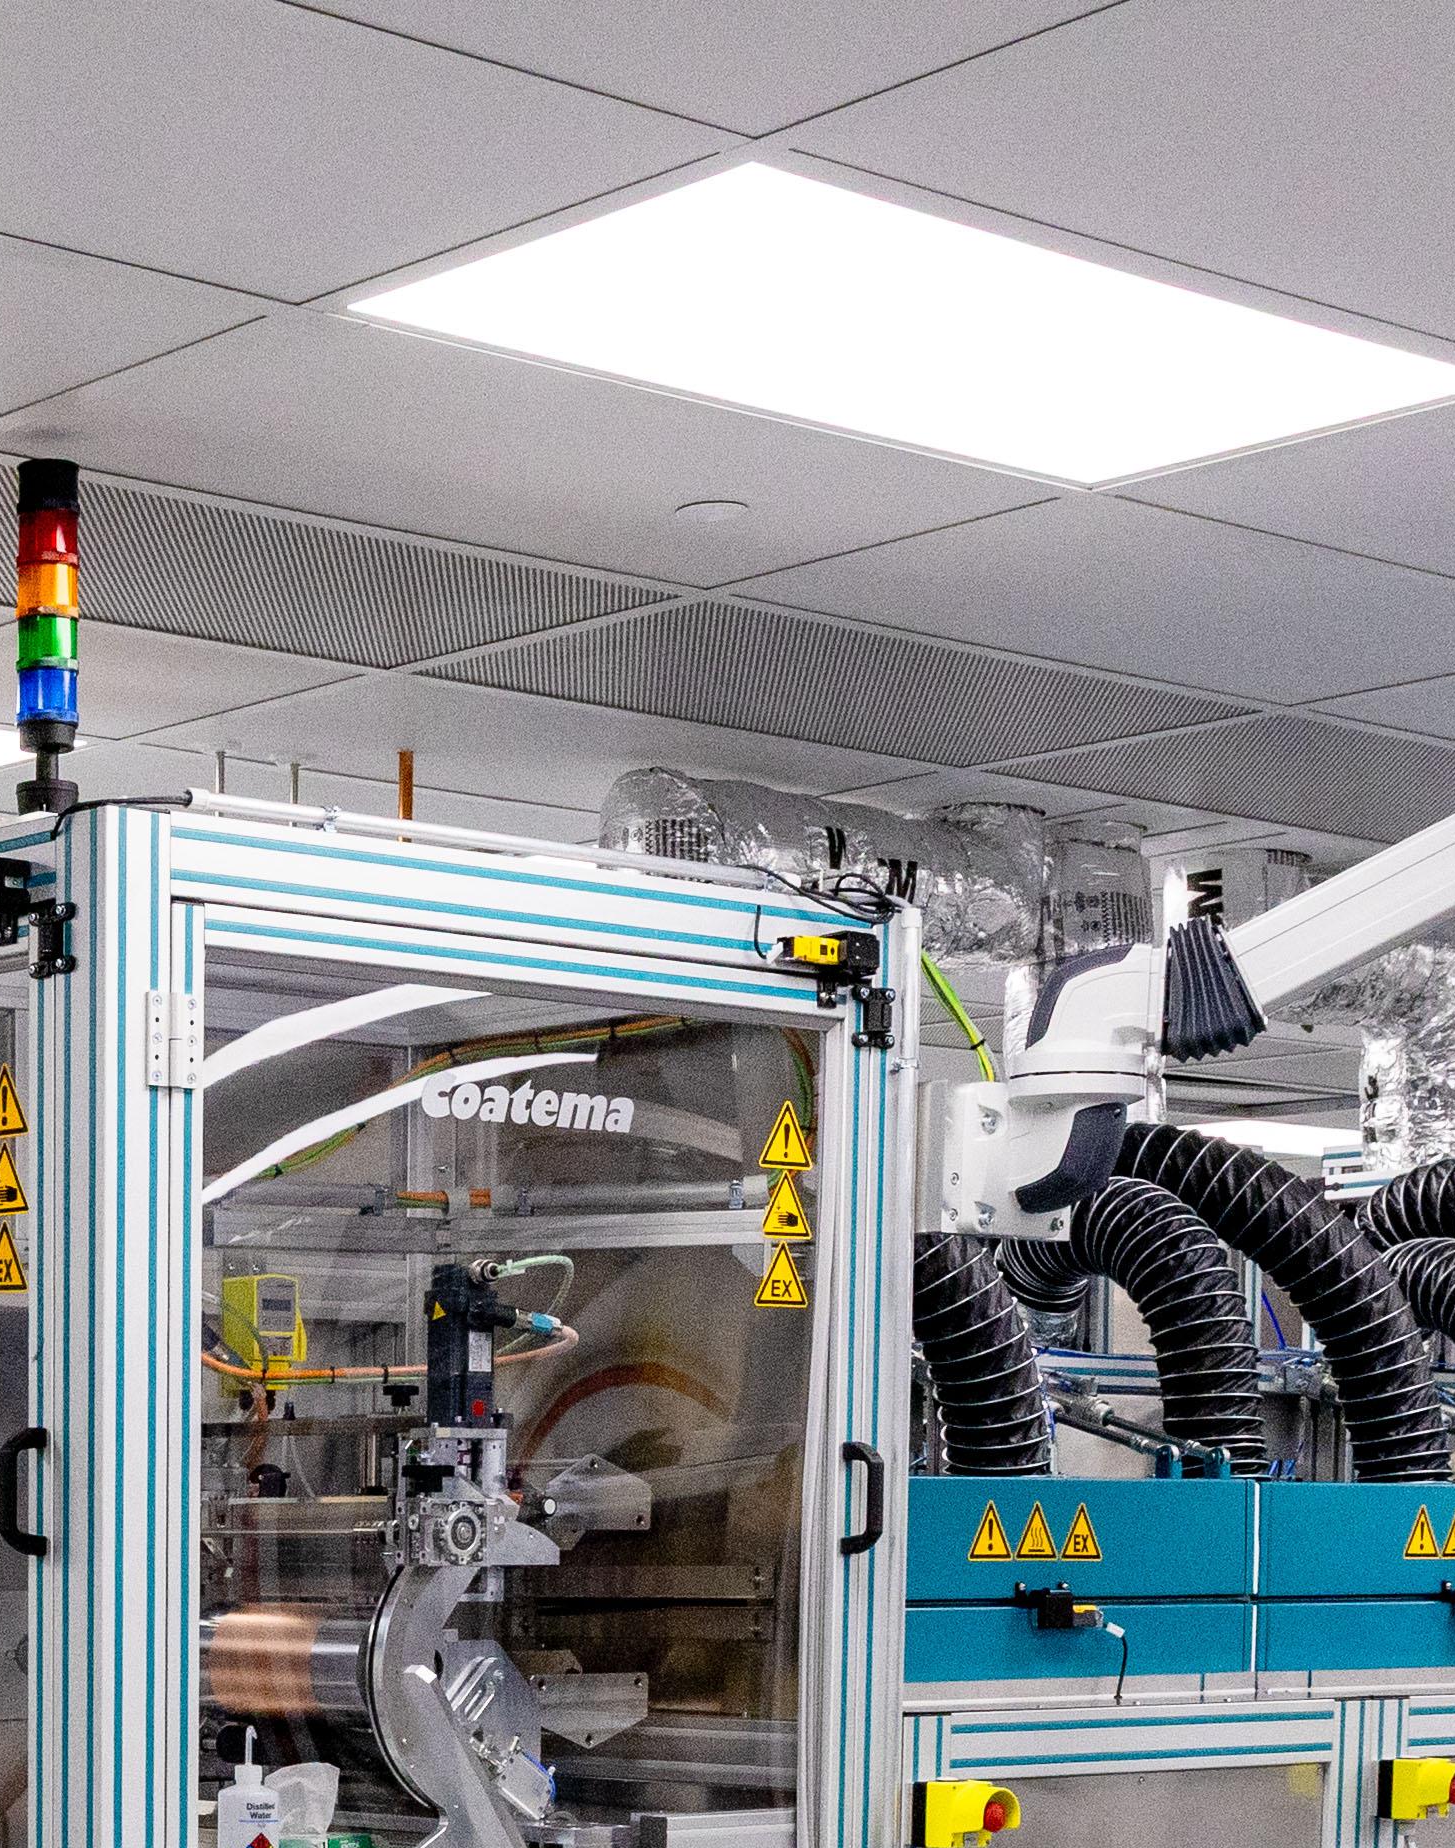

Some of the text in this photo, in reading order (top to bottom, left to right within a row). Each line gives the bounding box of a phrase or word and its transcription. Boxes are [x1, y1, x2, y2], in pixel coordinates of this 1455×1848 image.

[421, 1071, 634, 1133] Coatema
[771, 1280, 792, 1297] EX
[1073, 1534, 1089, 1552] EX
[249, 1811, 272, 1819] Water
